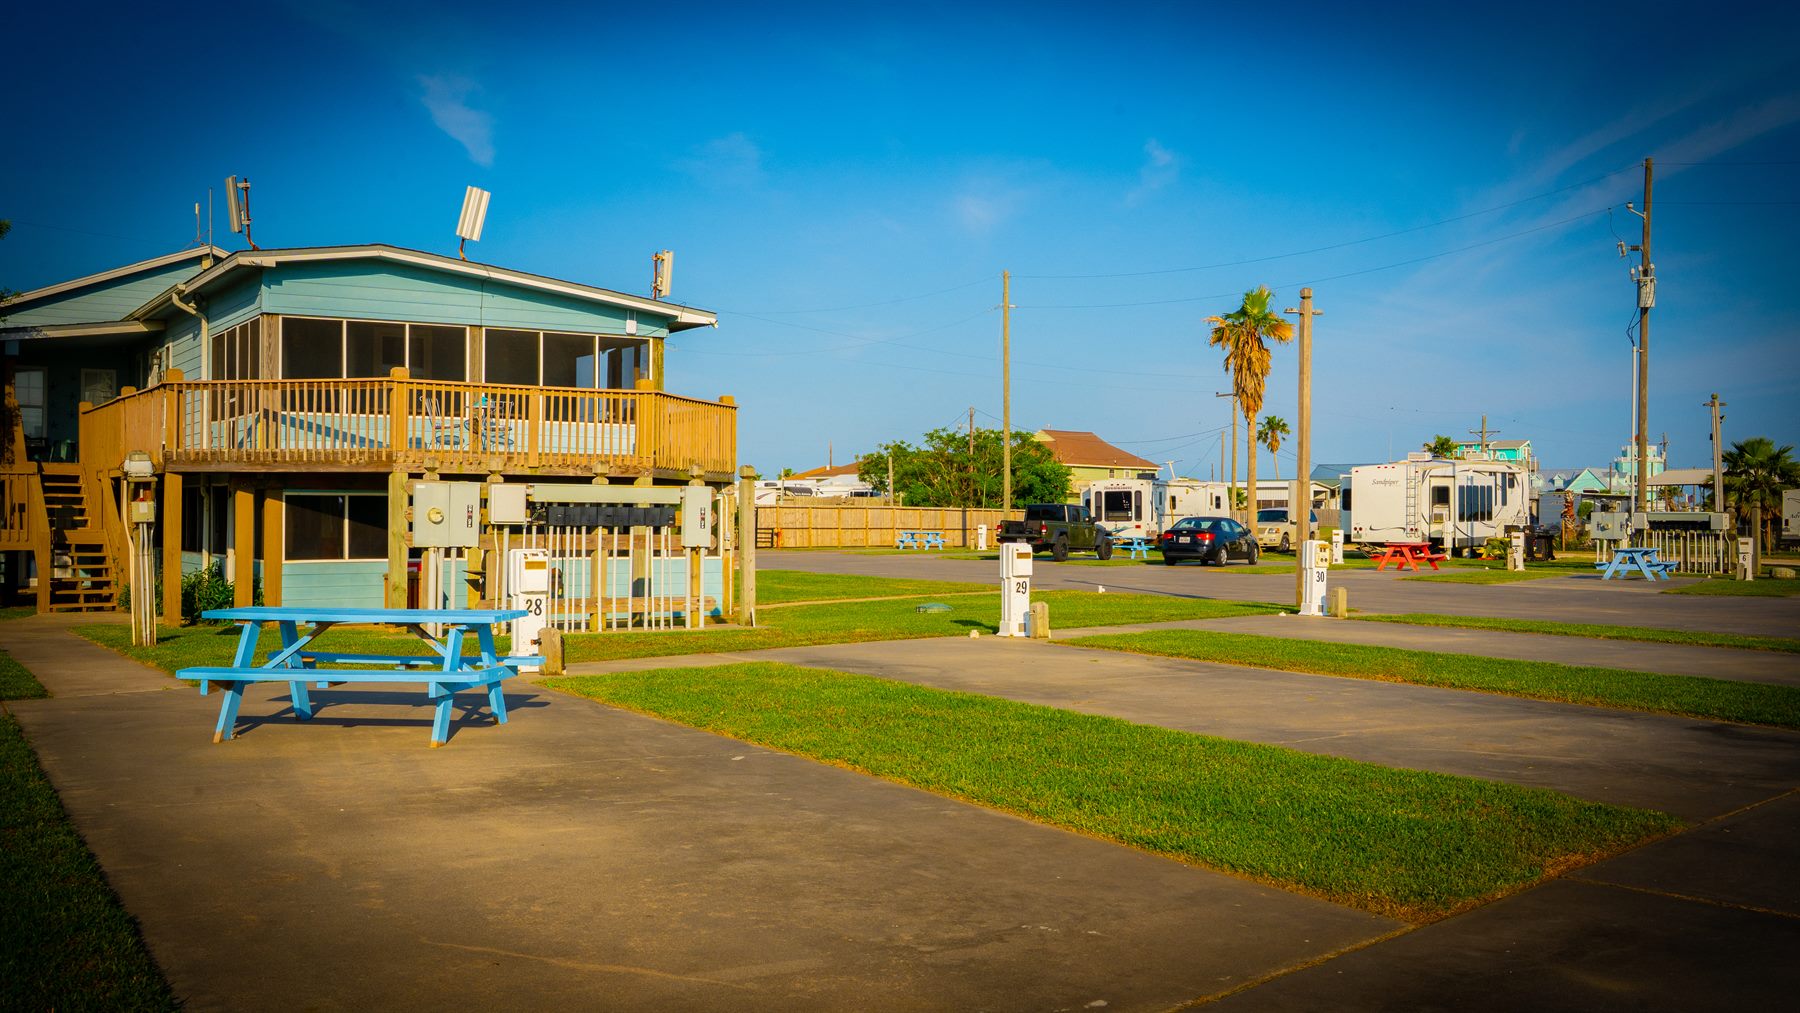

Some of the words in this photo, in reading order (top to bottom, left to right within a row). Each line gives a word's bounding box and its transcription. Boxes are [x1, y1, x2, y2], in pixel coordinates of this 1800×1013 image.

[1371, 478, 1399, 487] Sandpiper
[1316, 571, 1325, 582] 30
[1016, 581, 1028, 594] 29
[525, 598, 542, 616] 28
